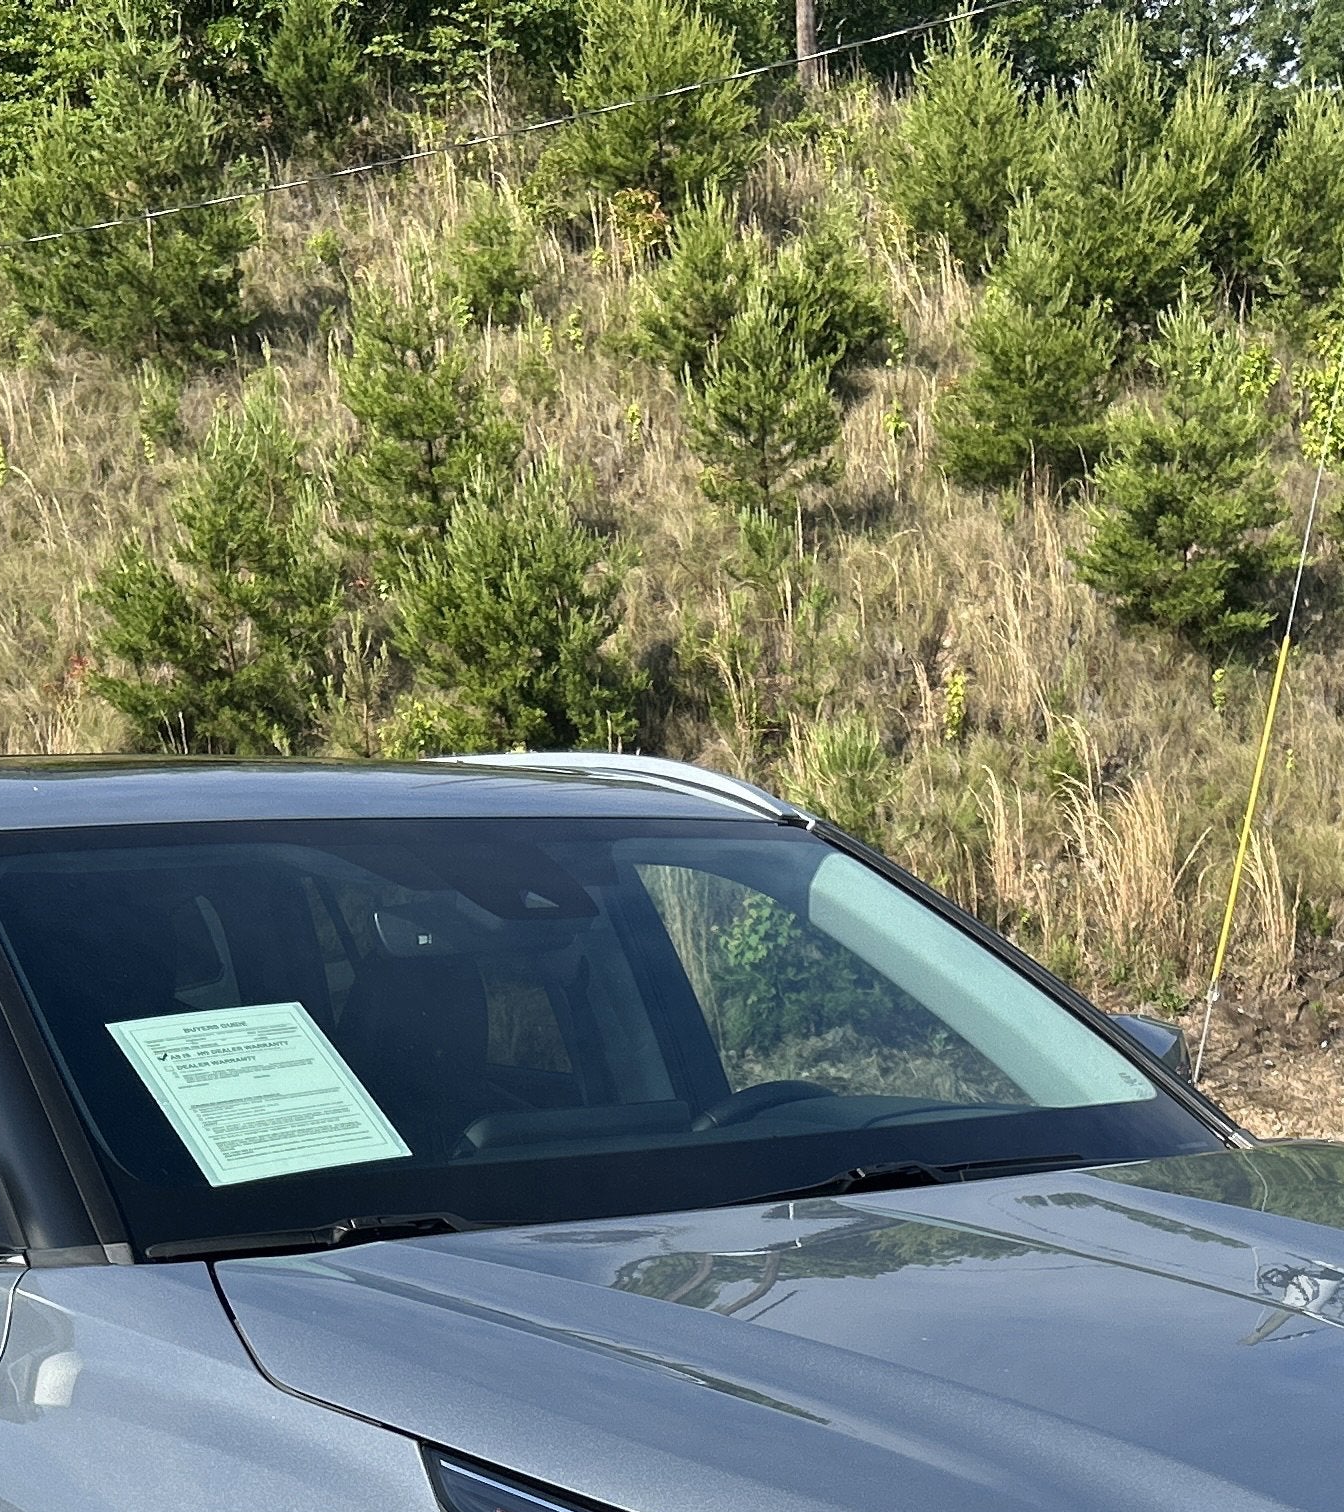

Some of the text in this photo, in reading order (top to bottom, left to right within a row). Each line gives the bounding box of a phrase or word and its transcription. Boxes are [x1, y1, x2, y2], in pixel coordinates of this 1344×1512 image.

[183, 1024, 220, 1034] BUYERS
[211, 1046, 244, 1055] DEALER
[244, 1040, 289, 1050] WARRANTY
[176, 1055, 256, 1071] DEALER WARRANTY
